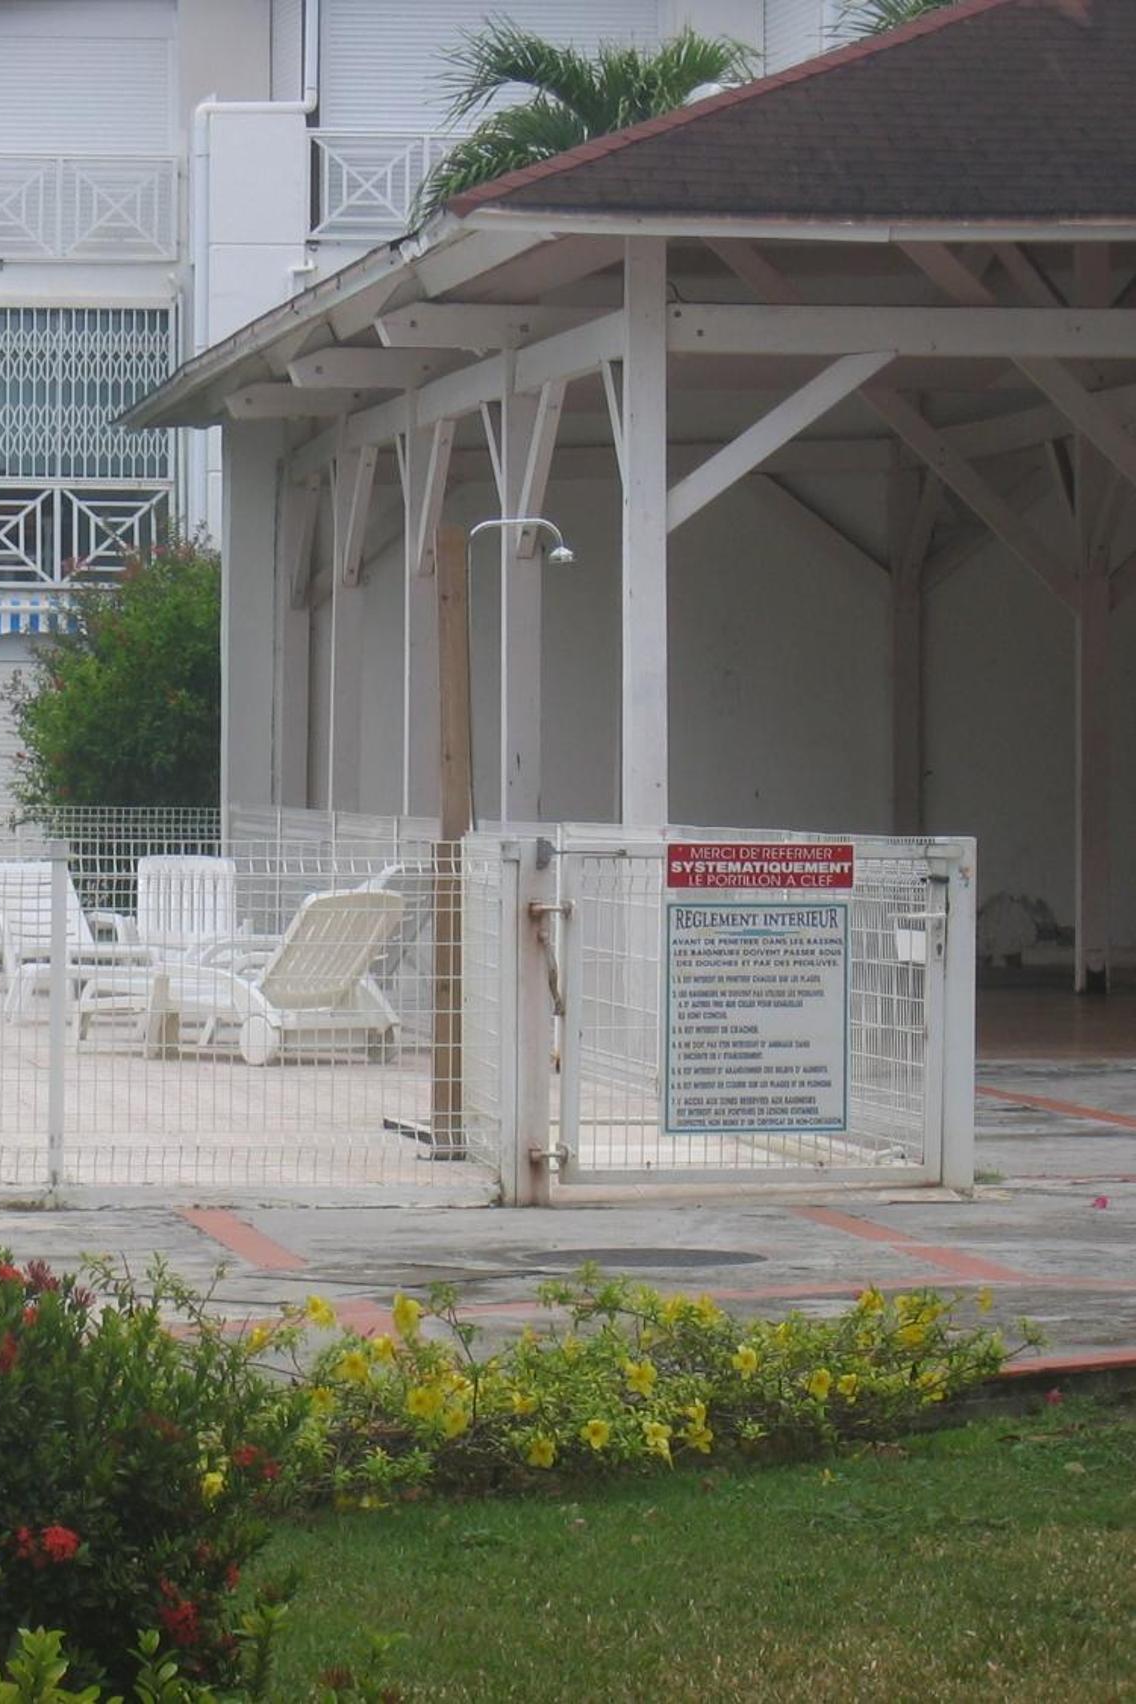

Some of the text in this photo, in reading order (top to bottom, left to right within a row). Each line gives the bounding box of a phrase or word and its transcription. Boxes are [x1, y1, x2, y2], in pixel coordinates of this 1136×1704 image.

[690, 847, 735, 859] MERCI
[762, 848, 832, 858] REFERMER
[671, 862, 851, 873] SYSTEMATIQUEMENT
[688, 875, 834, 886] LE PORTILLON A CLEF
[676, 908, 838, 929] REGLEMENT INTERIEUR
